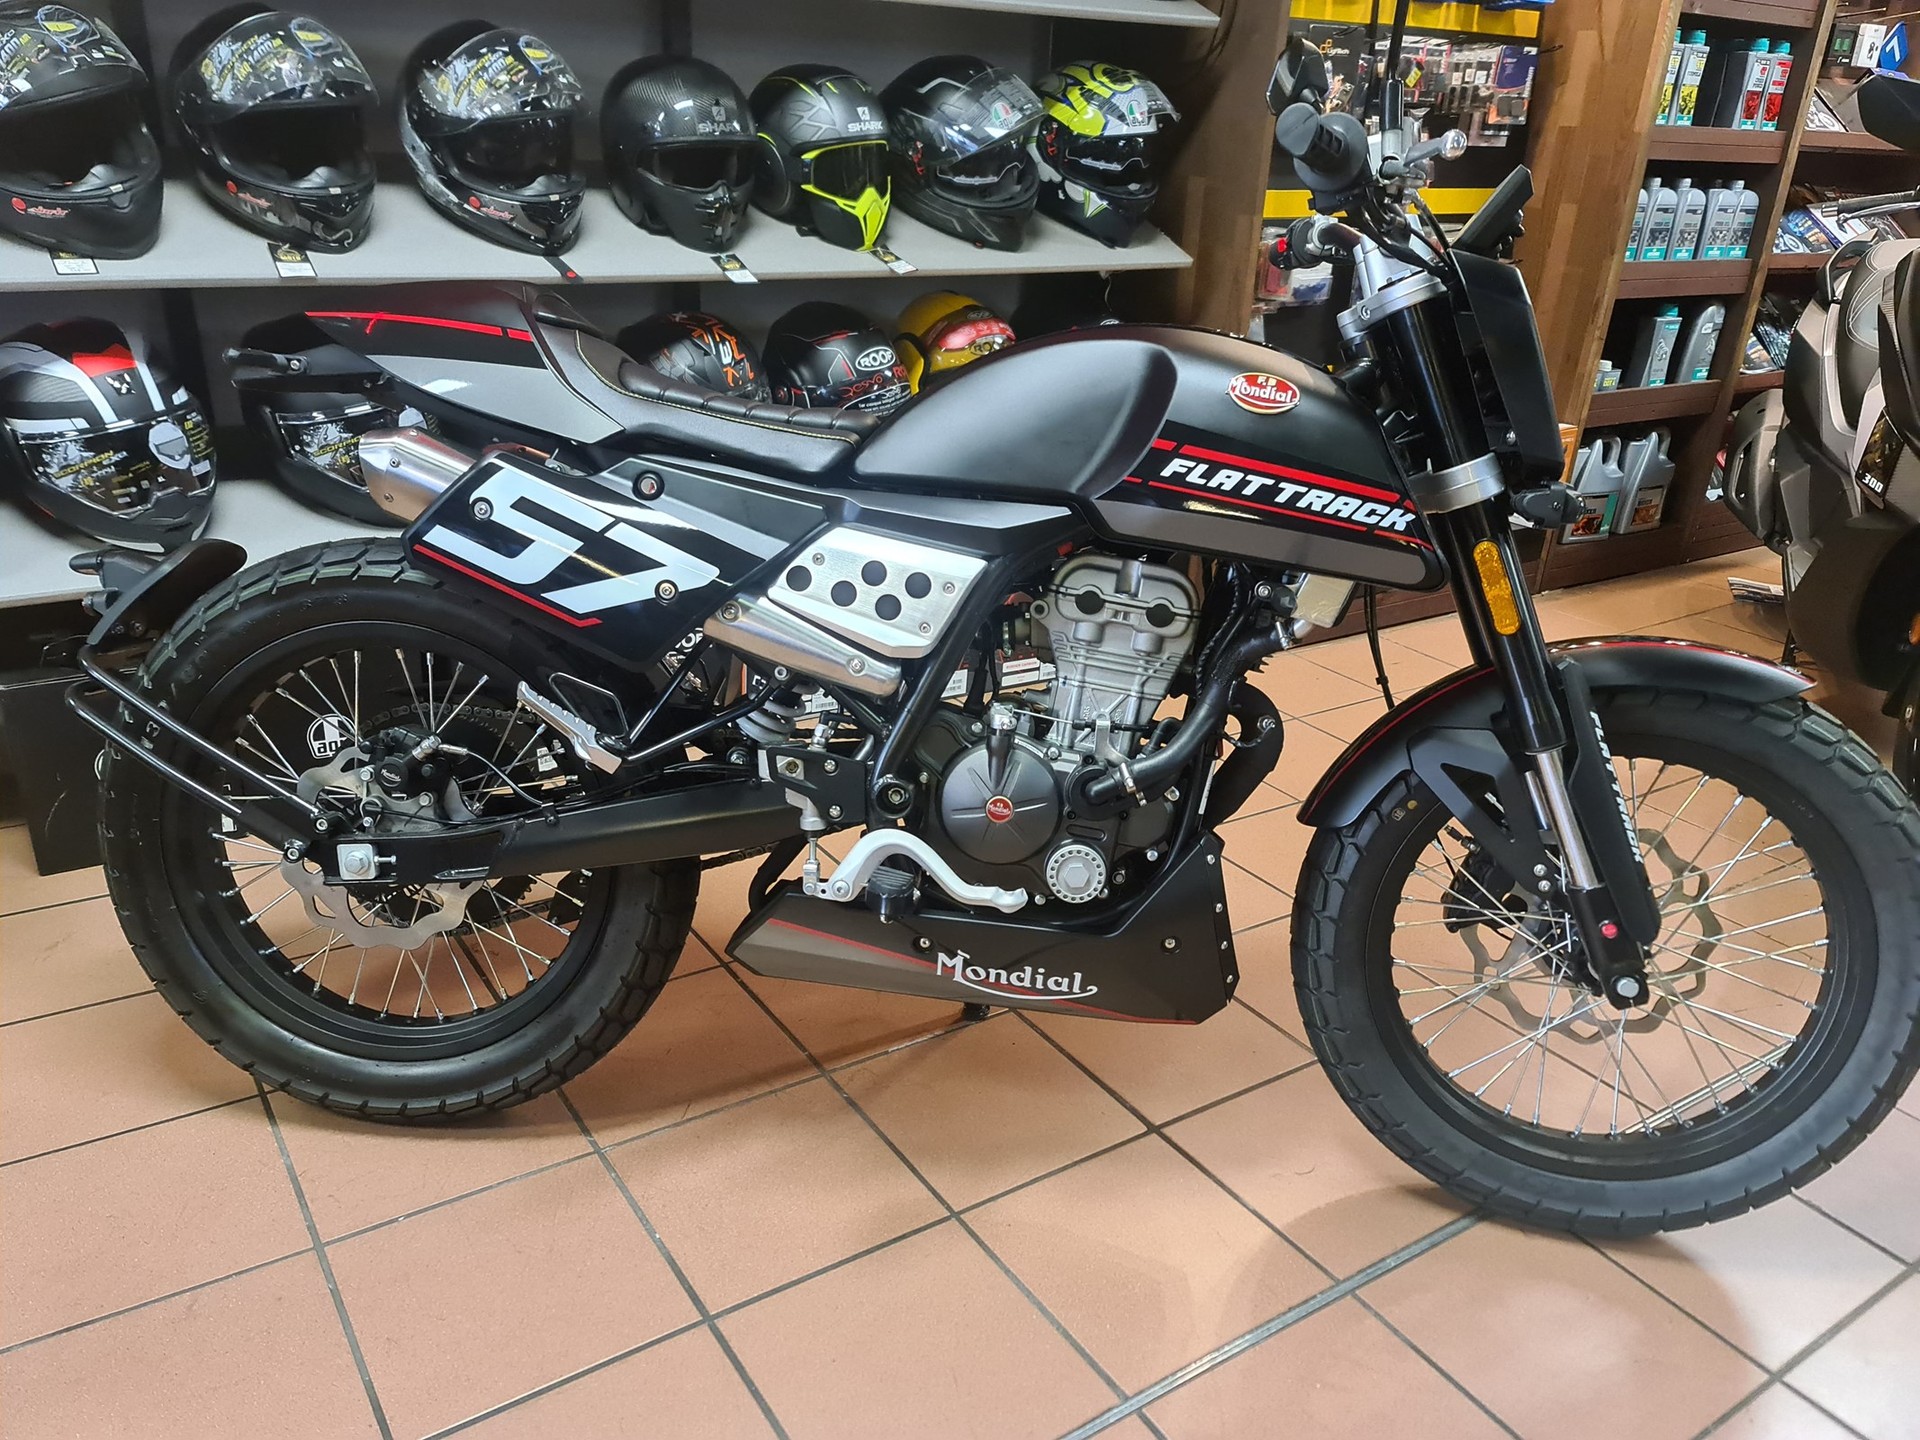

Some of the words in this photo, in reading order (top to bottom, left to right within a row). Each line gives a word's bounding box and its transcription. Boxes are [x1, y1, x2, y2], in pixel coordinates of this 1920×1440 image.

[848, 120, 883, 132] SHARK
[860, 350, 893, 367] ROOF
[1230, 376, 1298, 406] Mondial
[313, 434, 364, 457] SCORPIO
[53, 449, 115, 479] SCORPION
[1160, 457, 1273, 496] FLAT
[1274, 482, 1416, 531] TRACK
[1862, 472, 1884, 493] 300
[1590, 711, 1617, 778] FLAT
[1611, 779, 1645, 864] TRACK
[936, 950, 1094, 998] Mondial
